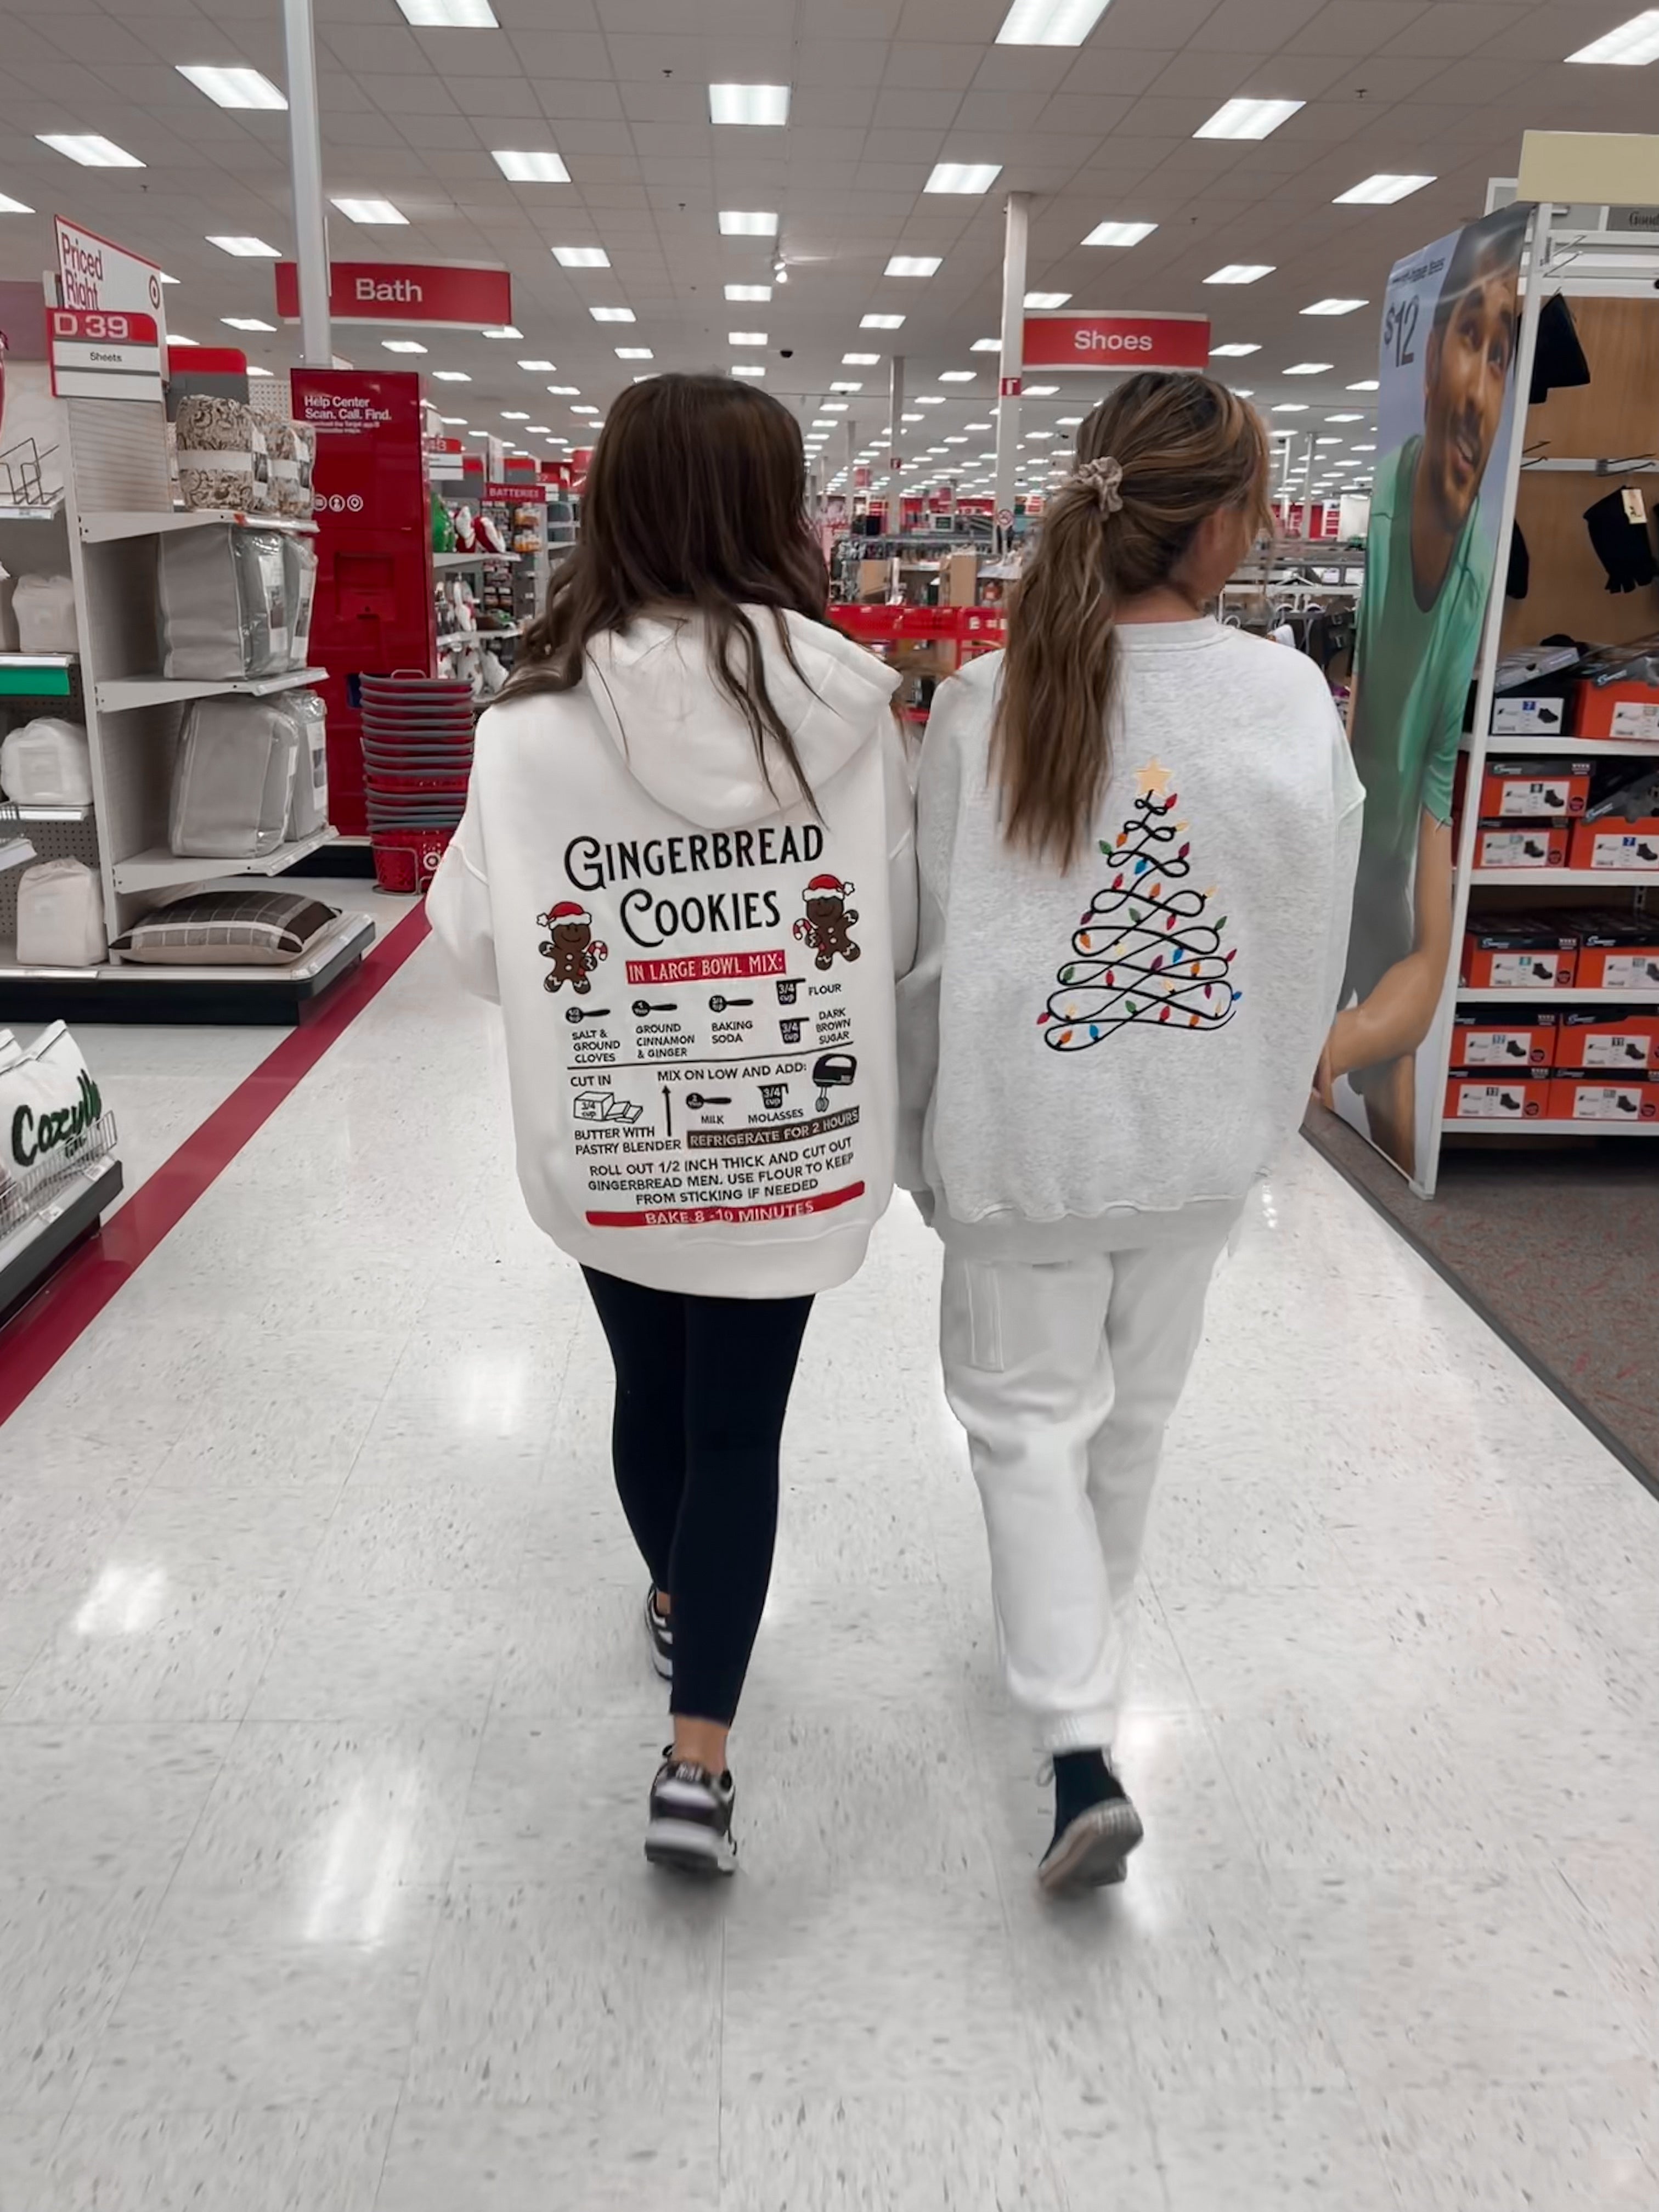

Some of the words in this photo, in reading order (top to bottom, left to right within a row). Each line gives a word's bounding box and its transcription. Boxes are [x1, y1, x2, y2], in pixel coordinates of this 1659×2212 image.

[61, 232, 103, 281] Priced
[65, 268, 100, 311] Right
[356, 278, 422, 302] Bath
[54, 312, 78, 336] D
[85, 315, 128, 339] 39
[1384, 294, 1419, 368] $12
[1074, 329, 1153, 351] Shoes
[89, 352, 122, 363] Sheets
[304, 395, 330, 408] Help
[332, 396, 370, 408] Center
[304, 408, 336, 420] Scan.
[338, 409, 363, 420] Call.
[365, 409, 392, 421] Find.
[564, 825, 824, 892] GINGERBREAD
[620, 888, 781, 947] COOKIES
[629, 964, 645, 982] IN
[650, 960, 696, 980] LARGE
[702, 957, 743, 978] BOWL
[748, 953, 784, 974] MIX:
[779, 983, 795, 995] 3/4
[809, 984, 842, 996] FLOUR
[819, 1008, 846, 1020] DARK
[636, 1023, 681, 1034] GROUND
[712, 1020, 753, 1032] BAKING
[781, 1022, 799, 1034] 3/4
[816, 1019, 851, 1033] BROWN
[572, 1030, 597, 1040] SALT
[600, 1029, 608, 1038] &
[636, 1035, 695, 1047] CINNAMON
[712, 1034, 743, 1044] SODA
[819, 1031, 850, 1045] SUGAR
[573, 1040, 620, 1051] GROUND
[575, 1053, 616, 1063] CLOVES
[637, 1050, 644, 1059] &
[648, 1048, 687, 1058] GINGER
[658, 1070, 681, 1081] MIX
[684, 1069, 704, 1080] ON
[708, 1068, 738, 1079] LOW
[742, 1066, 770, 1077] AND
[775, 1062, 807, 1075] ADD:
[571, 1076, 595, 1087] CUT
[598, 1075, 611, 1085] IN
[763, 1087, 781, 1098] 3/4
[701, 1115, 724, 1125] MILK
[748, 1109, 804, 1123] MOLASSES
[574, 1128, 620, 1141] BUTTER
[623, 1126, 655, 1138] WITH
[690, 1131, 780, 1147] REFRIGERATE
[783, 1126, 809, 1140] FOR
[812, 1123, 820, 1133] 2
[823, 1110, 859, 1131] HOURS
[575, 1143, 619, 1155] PASTRY
[623, 1139, 681, 1153] BLENDER
[590, 1165, 622, 1176] ROLL
[627, 1163, 653, 1175] OUT
[659, 1161, 680, 1174] 1/2
[685, 1158, 718, 1171] INCH
[722, 1154, 765, 1169] THICK
[769, 1151, 798, 1166] AND
[803, 1144, 826, 1159] CUT
[829, 1137, 852, 1152] OUT
[588, 1177, 682, 1191] GINGERBREAD
[687, 1175, 723, 1187] MEN.
[728, 1173, 754, 1185] USE
[758, 1166, 803, 1182] FLOUR
[806, 1161, 822, 1175] TO
[826, 1152, 854, 1170] KEEP
[636, 1192, 676, 1205] FROM
[680, 1189, 743, 1202] STICKING
[748, 1187, 759, 1199] IF
[765, 1178, 819, 1197] NEEDED
[645, 1211, 688, 1225] BAKE
[694, 1211, 705, 1222] 8
[738, 1201, 814, 1222] MINUTES
